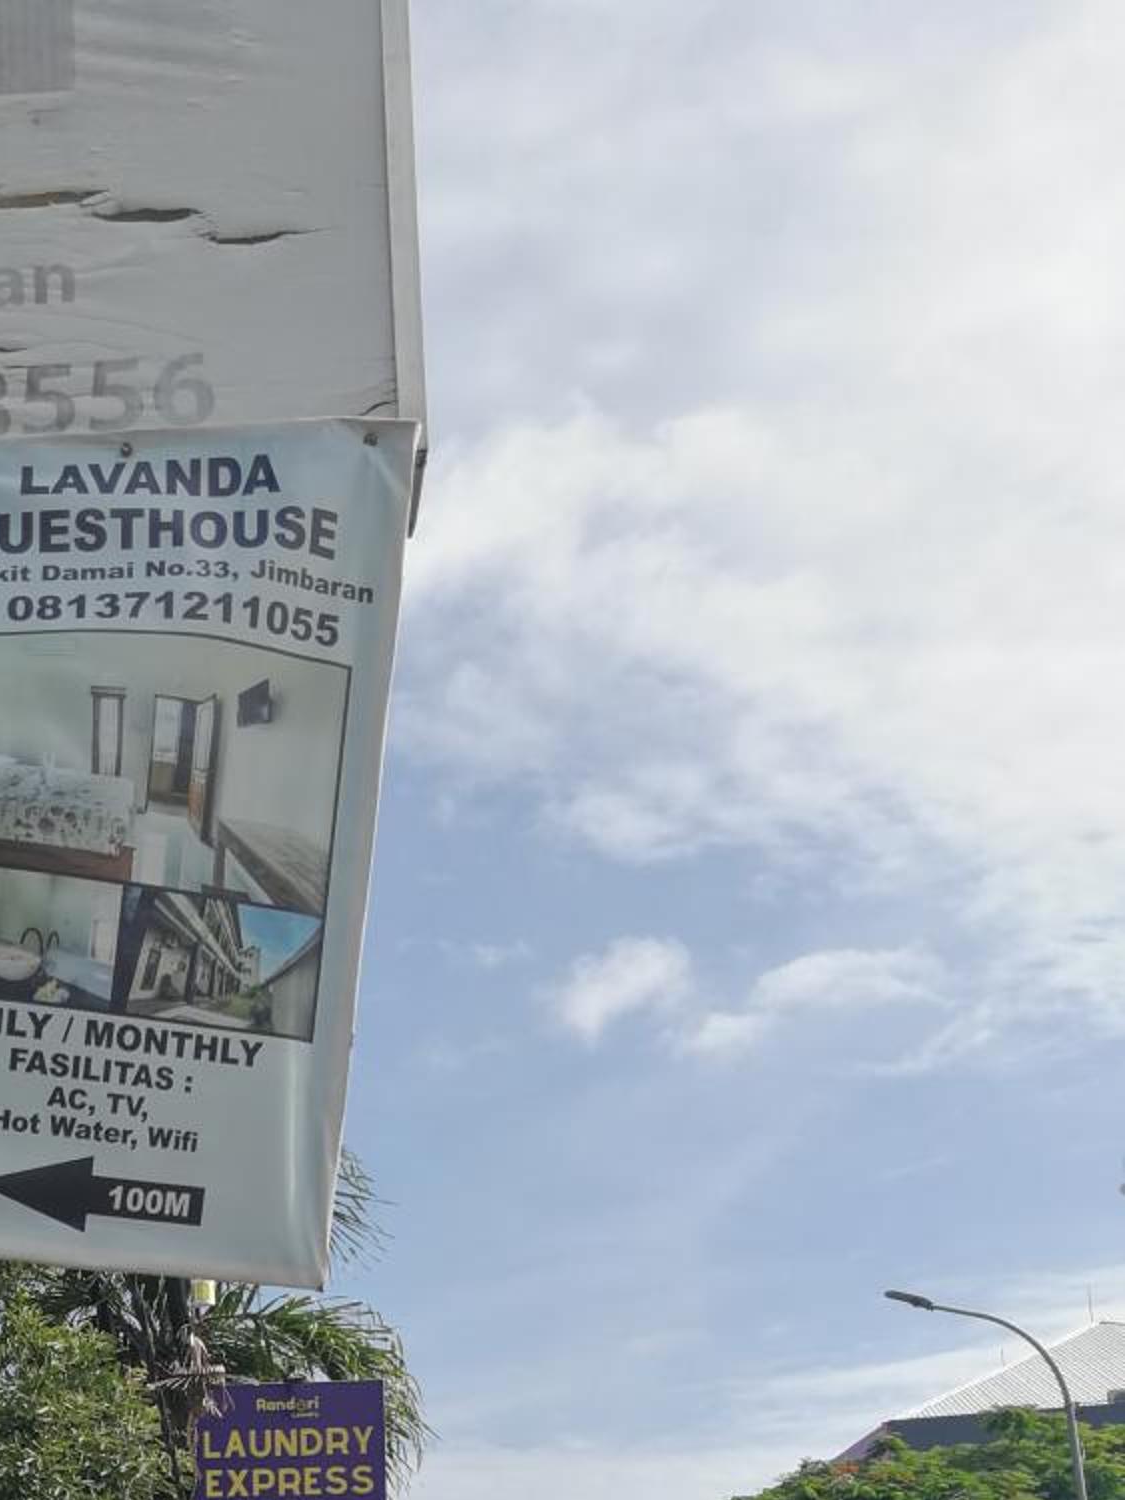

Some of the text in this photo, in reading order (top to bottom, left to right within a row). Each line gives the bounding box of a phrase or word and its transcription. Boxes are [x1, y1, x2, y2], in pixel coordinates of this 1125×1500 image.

[21, 454, 281, 497] LAVANDA
[42, 562, 134, 582] Damai
[145, 559, 239, 581] No.33,
[251, 560, 374, 604] Jimbaran
[7, 591, 340, 647] 081371211055
[84, 1018, 264, 1067] MONTHLY
[8, 1047, 174, 1091] FASILITAS
[47, 1086, 149, 1122] AC, TV,
[49, 1115, 138, 1150] Water,
[148, 1126, 199, 1153] Wifi
[108, 1184, 192, 1217] 100M
[202, 1425, 373, 1459] LAUNDRY
[205, 1464, 375, 1498] EXPRESS
